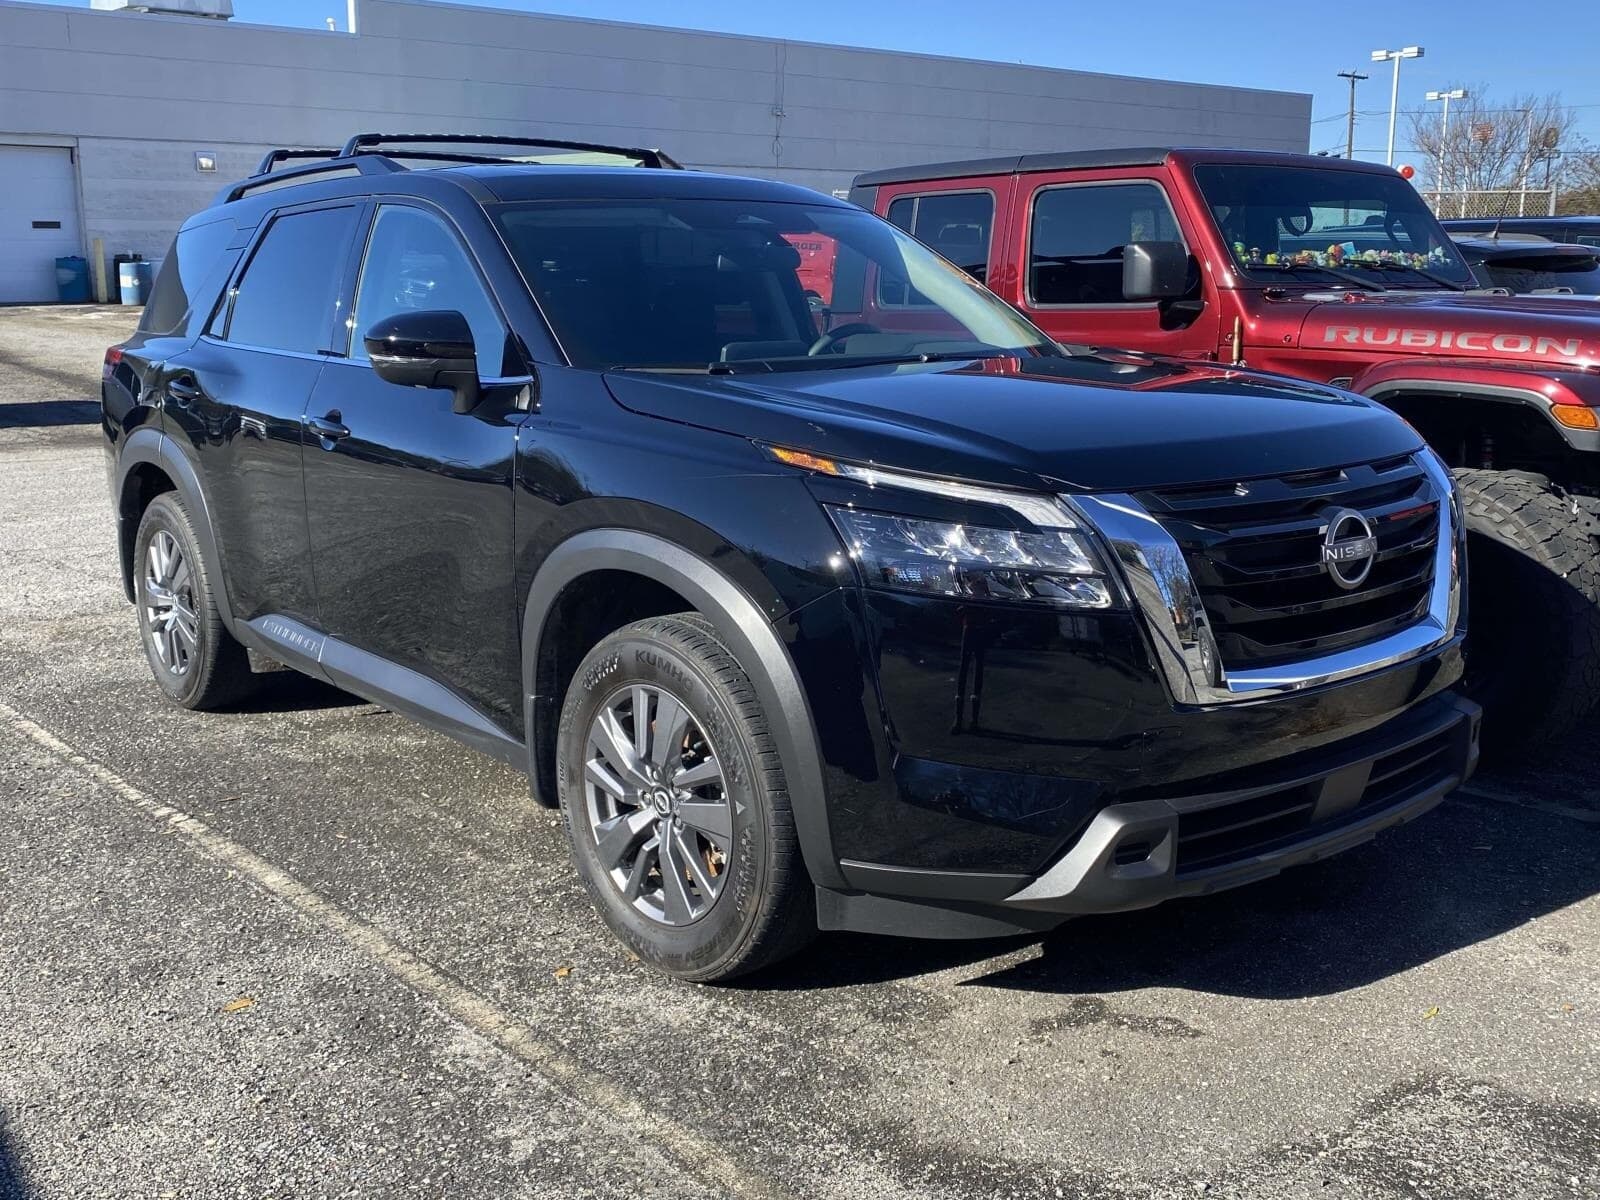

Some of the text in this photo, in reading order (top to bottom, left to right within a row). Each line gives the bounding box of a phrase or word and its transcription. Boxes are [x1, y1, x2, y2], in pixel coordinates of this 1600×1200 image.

[1324, 326, 1581, 355] RUBICON
[1325, 541, 1377, 562] NISSAN
[635, 650, 694, 692] KUMHO
